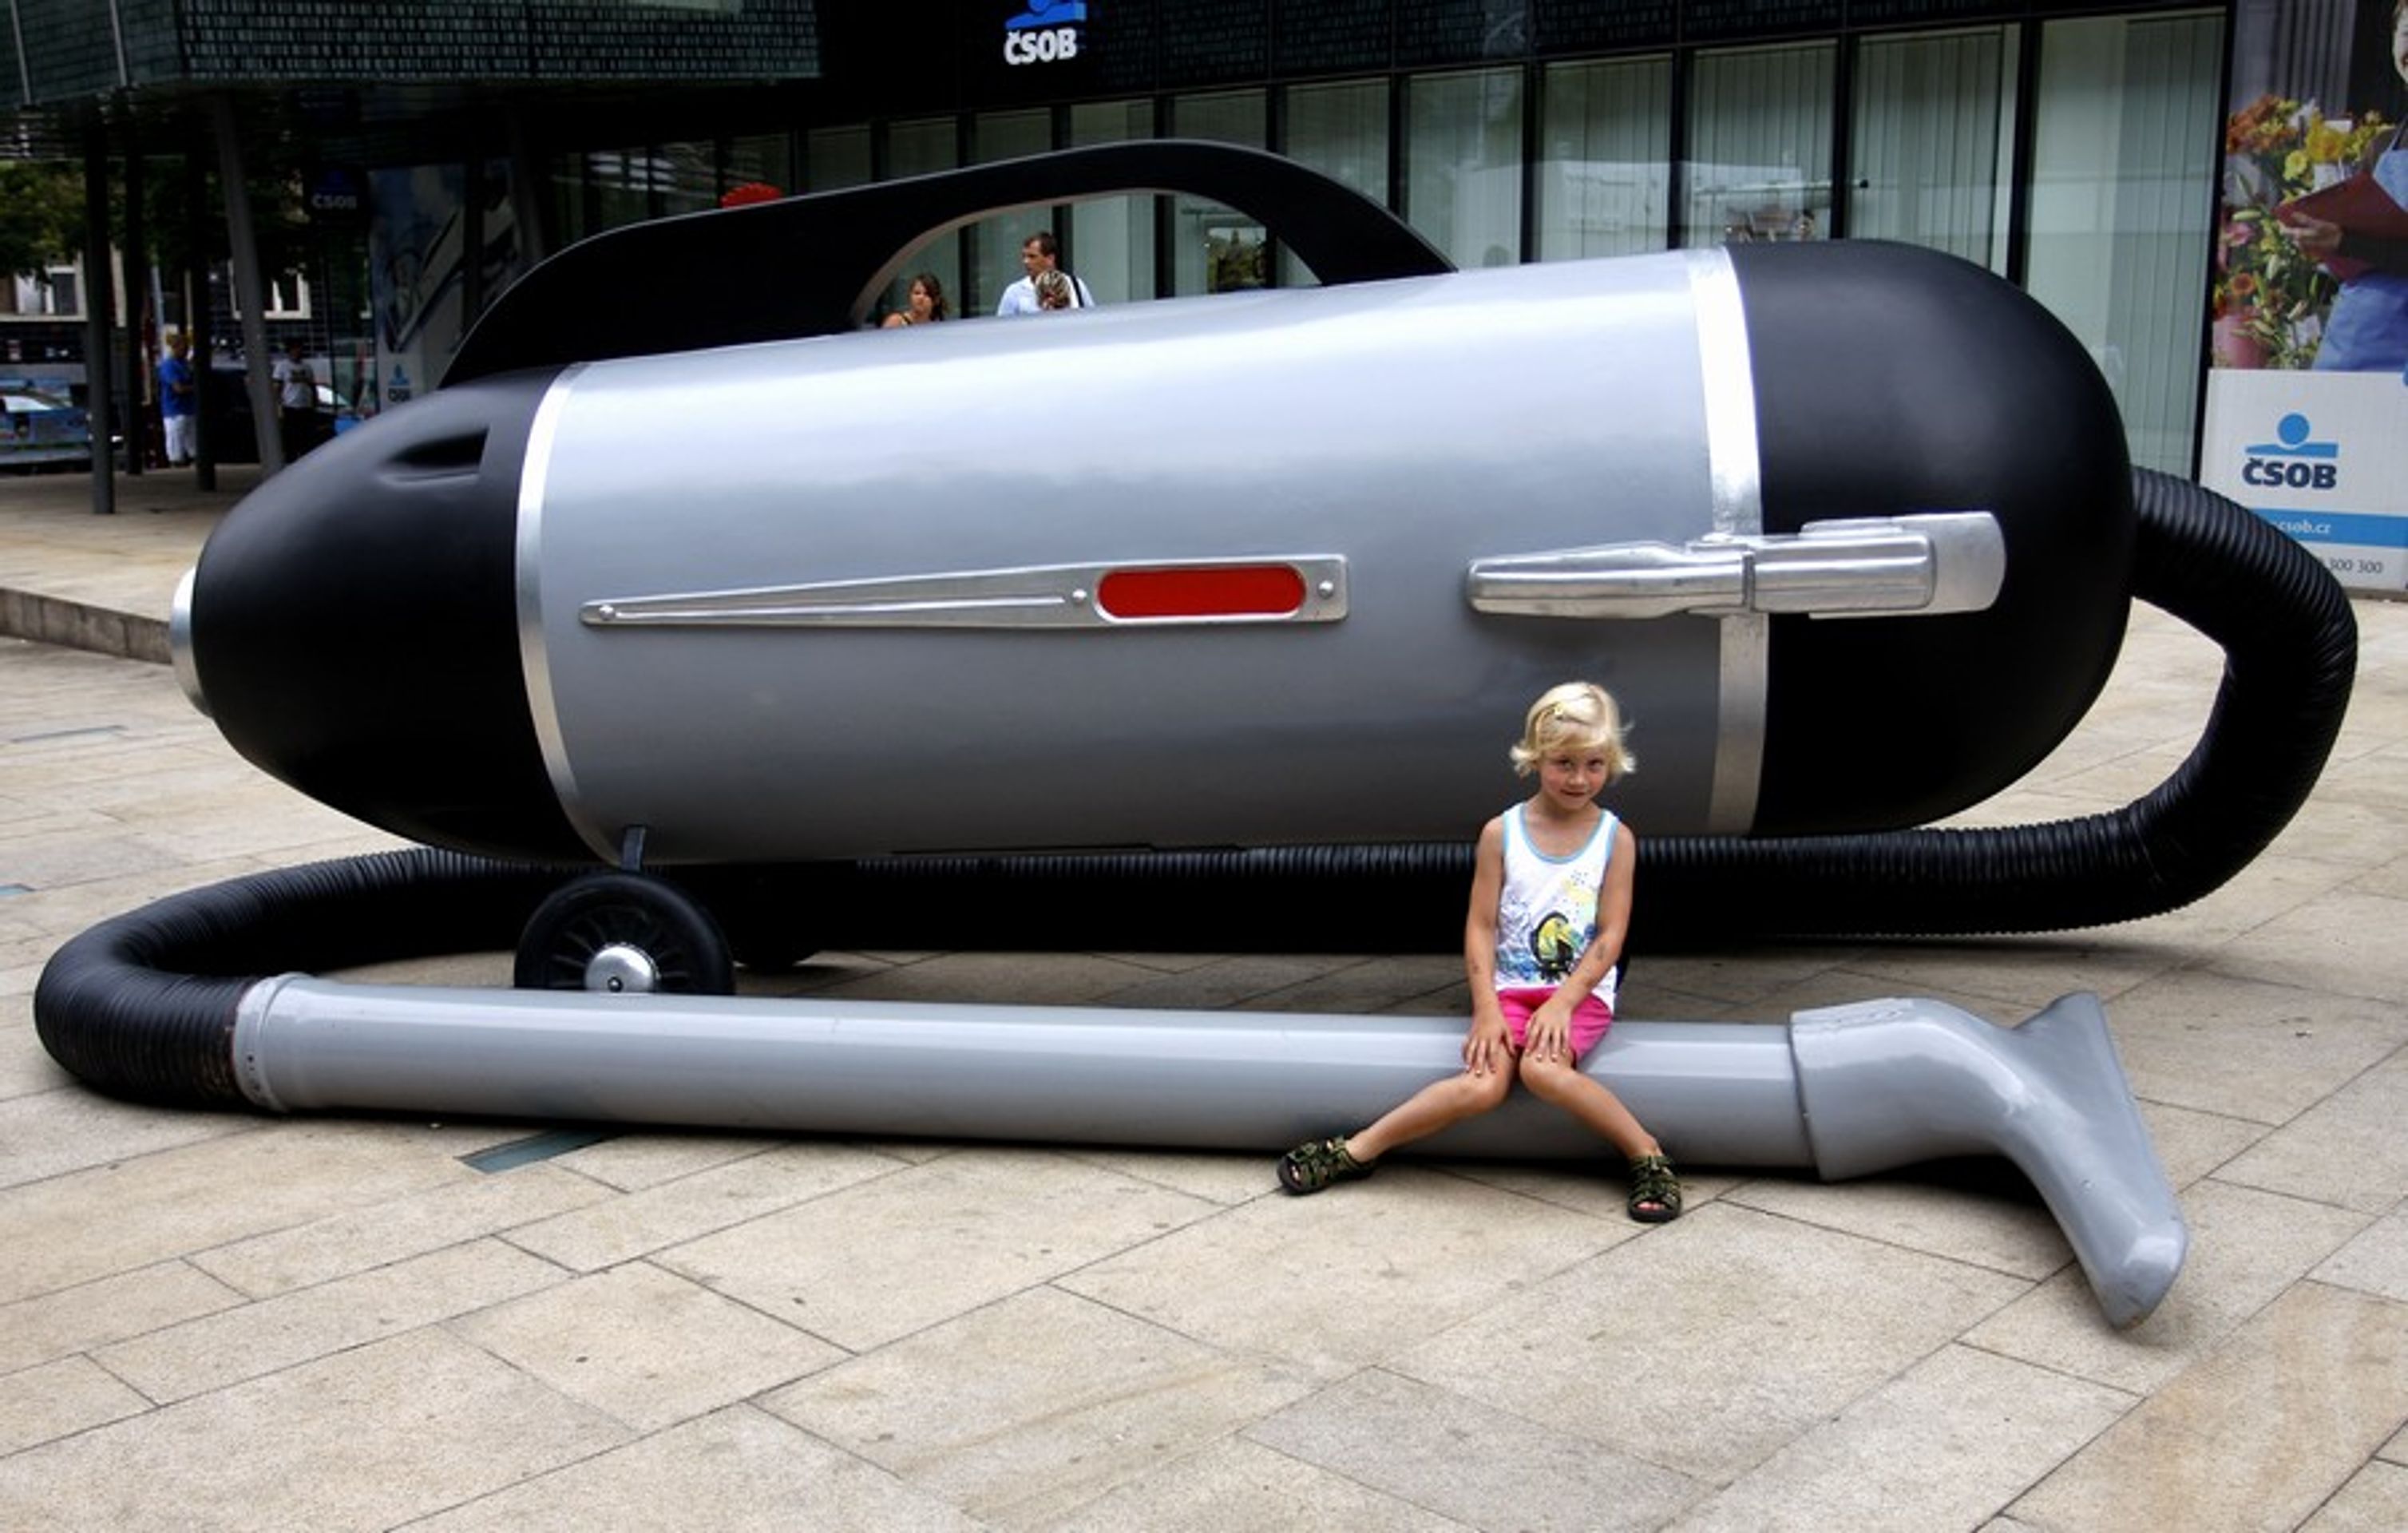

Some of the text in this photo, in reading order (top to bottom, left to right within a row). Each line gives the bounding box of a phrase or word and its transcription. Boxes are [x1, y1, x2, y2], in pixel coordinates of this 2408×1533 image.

[1004, 27, 1077, 65] ČSOB
[2242, 458, 2337, 489] ČSOB
[2357, 560, 2383, 573] 300
